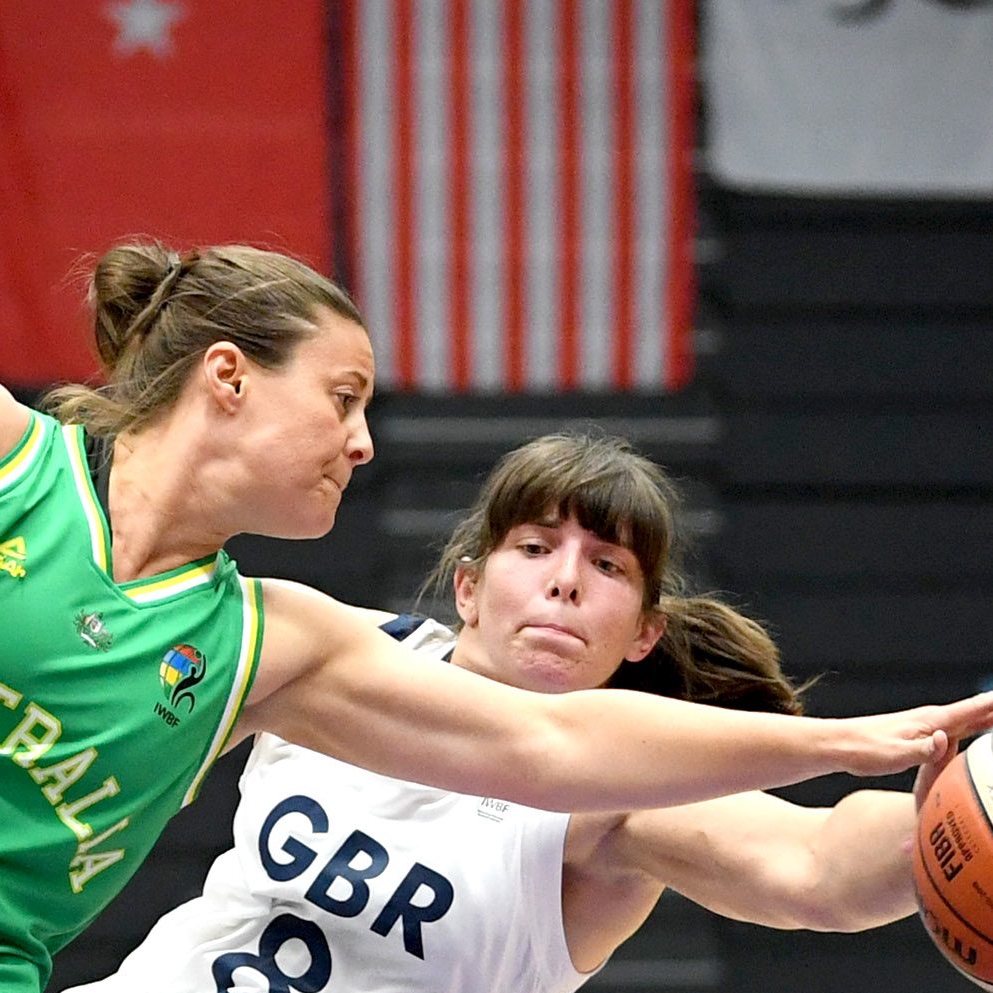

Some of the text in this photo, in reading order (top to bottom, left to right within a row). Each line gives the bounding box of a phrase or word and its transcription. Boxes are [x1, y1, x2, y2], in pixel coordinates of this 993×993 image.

[153, 702, 180, 728] IWBF
[259, 795, 454, 960] GBR
[929, 821, 964, 882] FIBA
